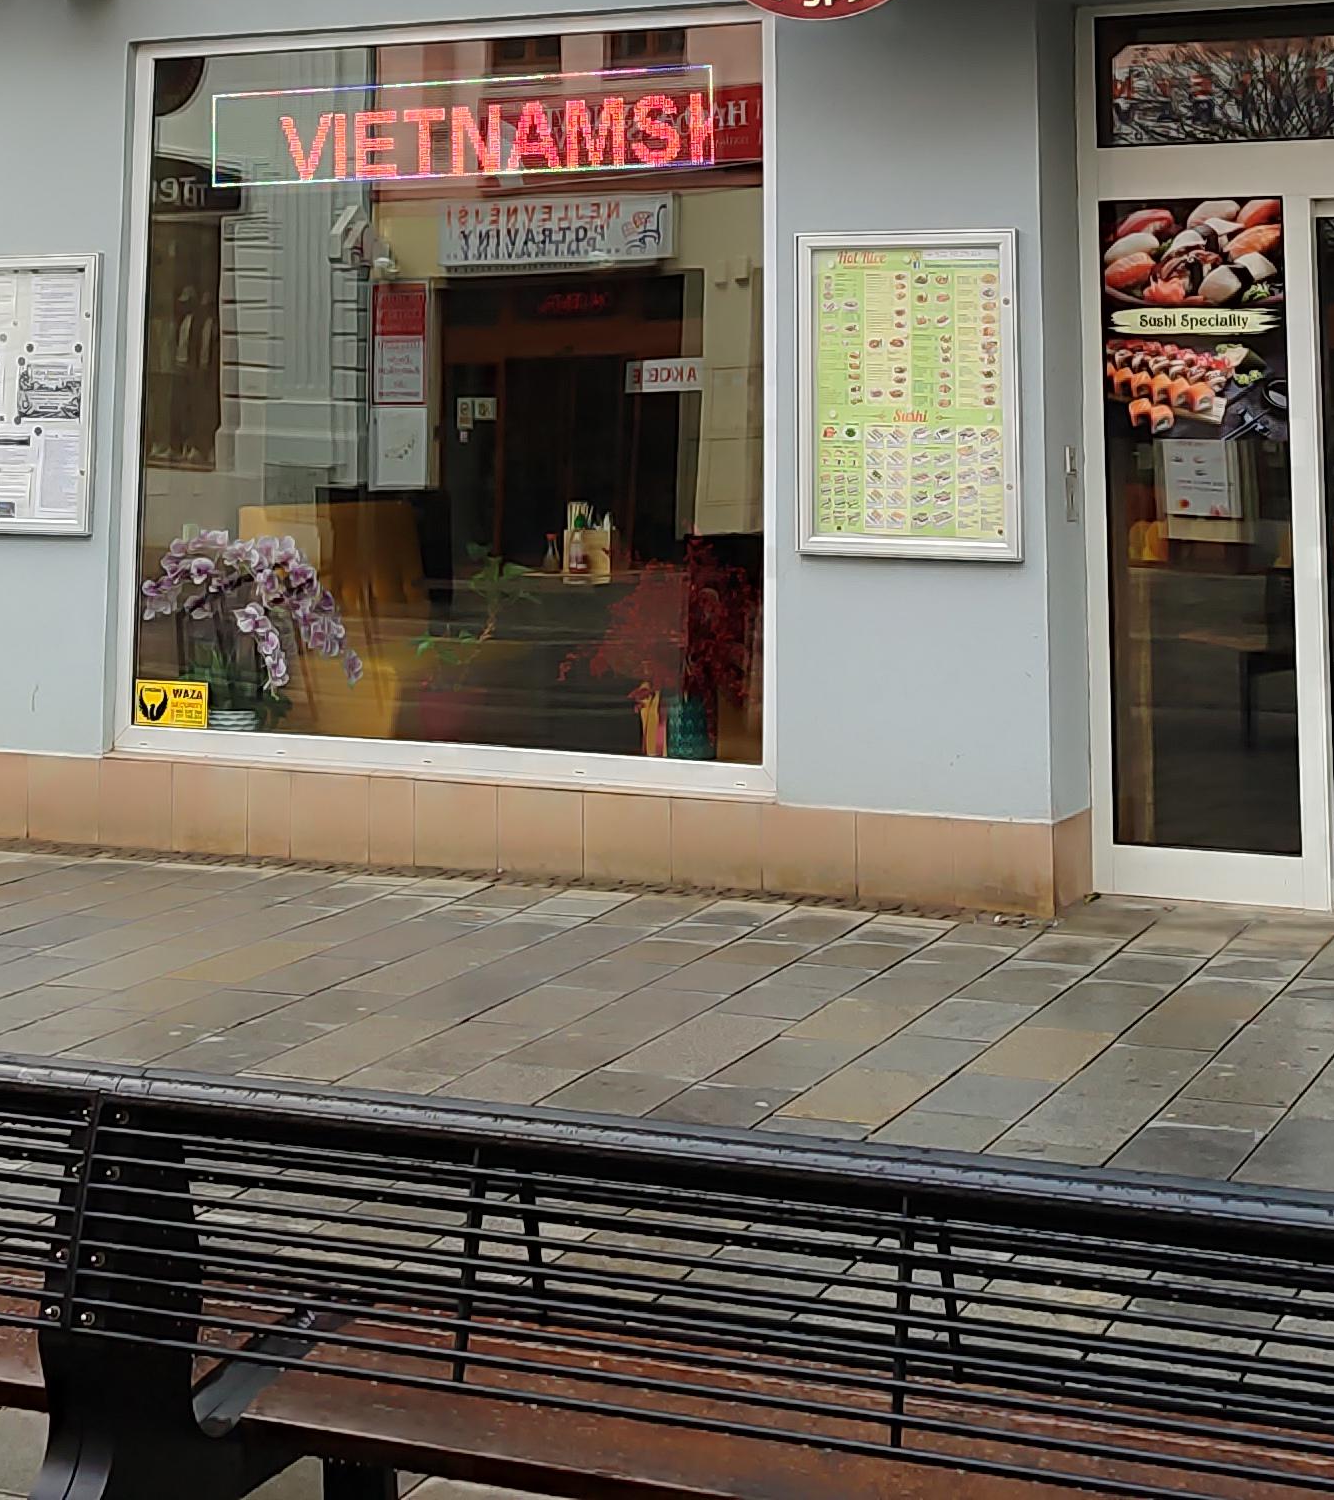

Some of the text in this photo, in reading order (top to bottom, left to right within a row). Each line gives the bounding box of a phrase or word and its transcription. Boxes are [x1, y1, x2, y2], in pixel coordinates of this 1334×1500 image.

[1140, 313, 1249, 330] Sushi Speciality
[892, 409, 928, 423] Sushi
[173, 689, 202, 699] WAZA
